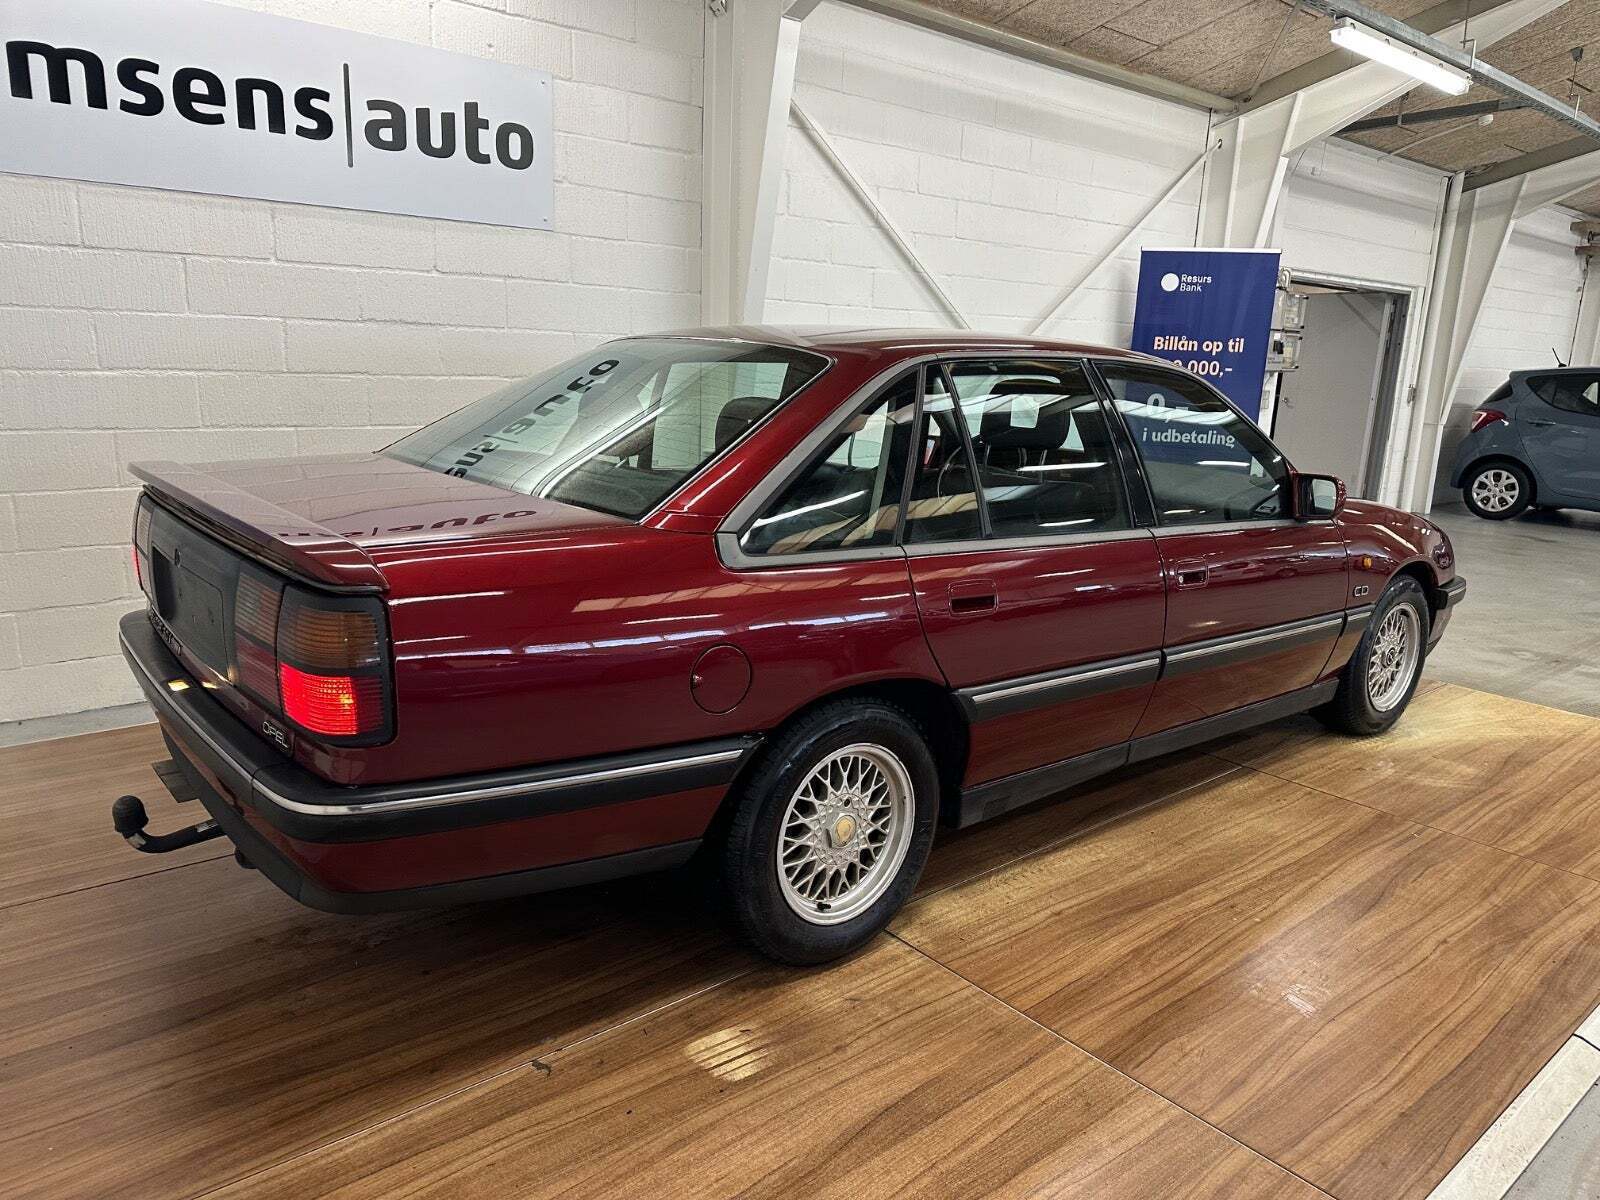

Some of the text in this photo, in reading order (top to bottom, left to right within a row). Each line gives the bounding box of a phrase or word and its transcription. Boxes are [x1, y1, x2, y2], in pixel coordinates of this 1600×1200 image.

[1181, 274, 1212, 284] Resurs
[1180, 283, 1202, 292] Bank
[1153, 335, 1245, 356] Billån op til
[1142, 427, 1236, 449] i udbetaling
[1354, 585, 1369, 597] CD
[262, 721, 288, 748] OPEL
